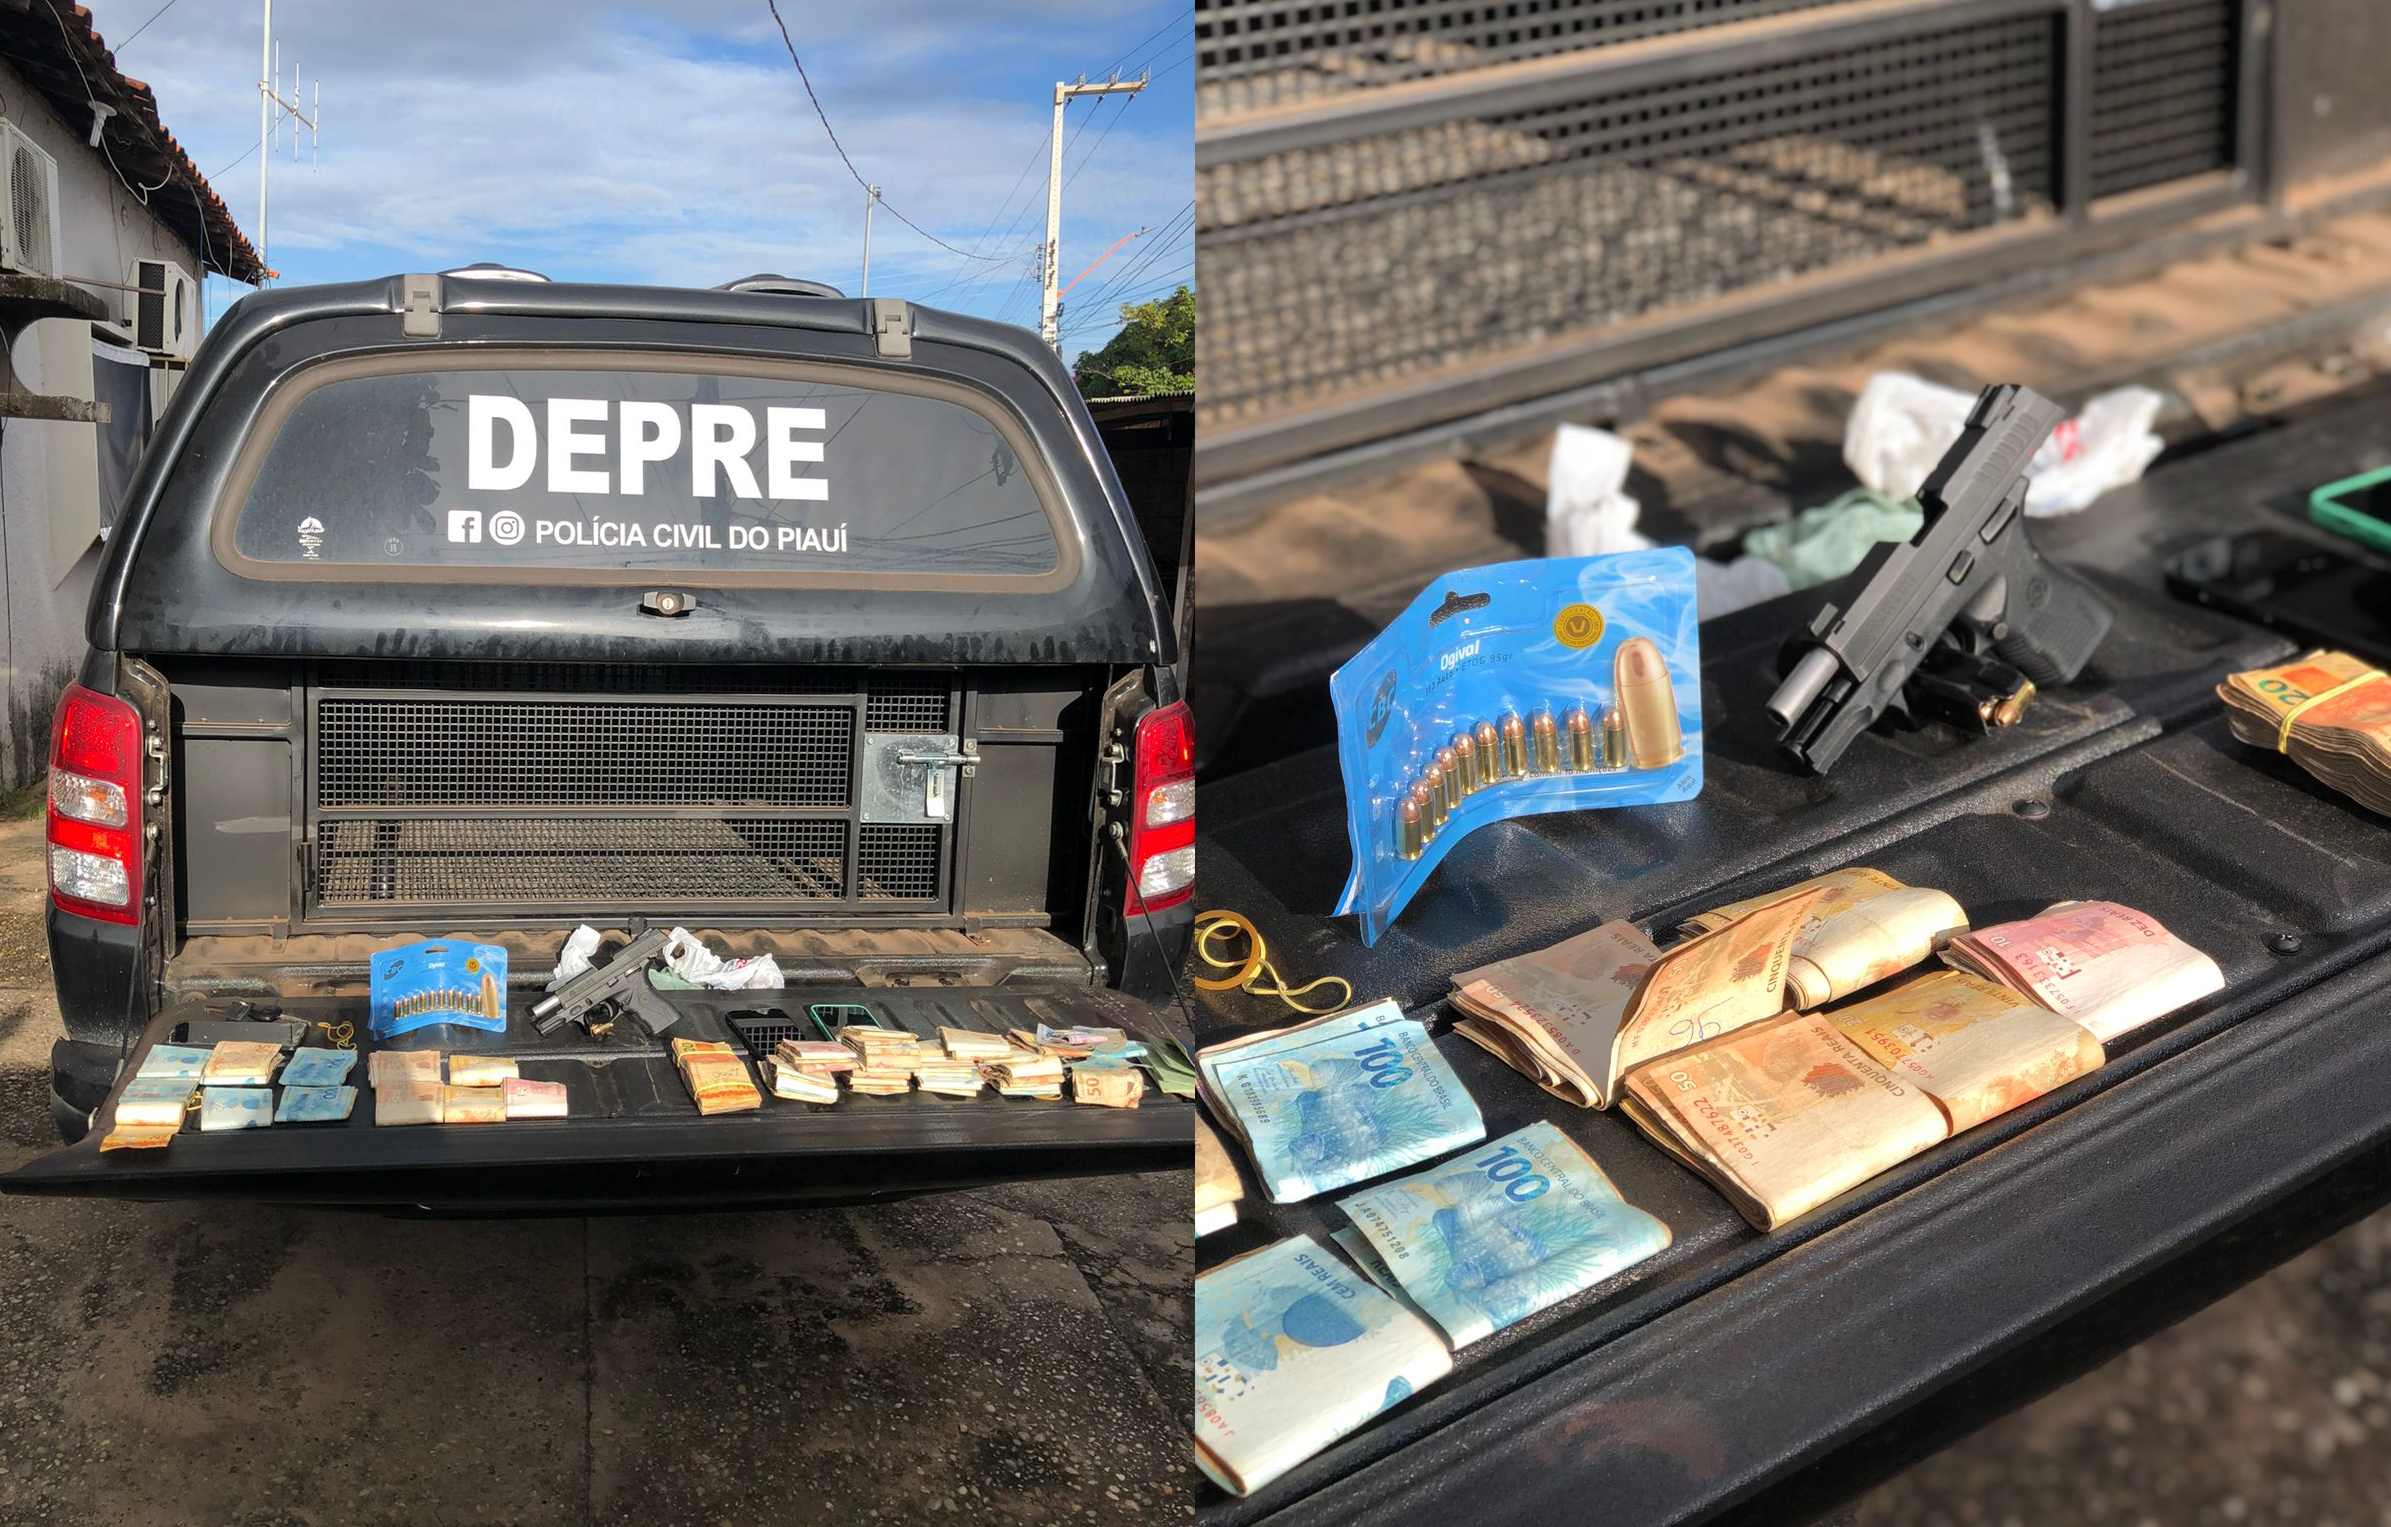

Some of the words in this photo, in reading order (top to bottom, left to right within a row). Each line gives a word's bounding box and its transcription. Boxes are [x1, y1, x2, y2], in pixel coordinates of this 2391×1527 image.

[468, 394, 829, 501] DEPRE
[536, 514, 647, 547] POLÍCIA
[653, 523, 722, 549] CIVIL
[729, 525, 769, 551] DO
[778, 522, 847, 553] PIAUÍ
[1441, 639, 1480, 671] Ogival
[1436, 671, 1454, 687] Auto
[1610, 932, 1645, 954] REAIS
[1989, 935, 2012, 949] 10
[2132, 919, 2155, 938] DEZ
[1988, 987, 2020, 1009] VINTE
[1810, 1026, 1847, 1055] REAIS
[1353, 1037, 1414, 1090] 100
[1398, 1031, 1418, 1054] BANCO
[1411, 1052, 1433, 1078] CENTRAL
[1426, 1075, 1440, 1088] DO
[1433, 1085, 1452, 1110] BRASIL
[1845, 1053, 1907, 1098] CINQUENTA
[1086, 1077, 1101, 1097] 50
[1669, 1071, 1697, 1093] 50
[1476, 1145, 1551, 1203] 100
[1517, 1137, 1544, 1159] BANCO
[1540, 1158, 1573, 1190] CENTRAL
[1568, 1188, 1585, 1200] DO
[1294, 1252, 1331, 1281] REAIS
[1326, 1278, 1356, 1300] CEM
